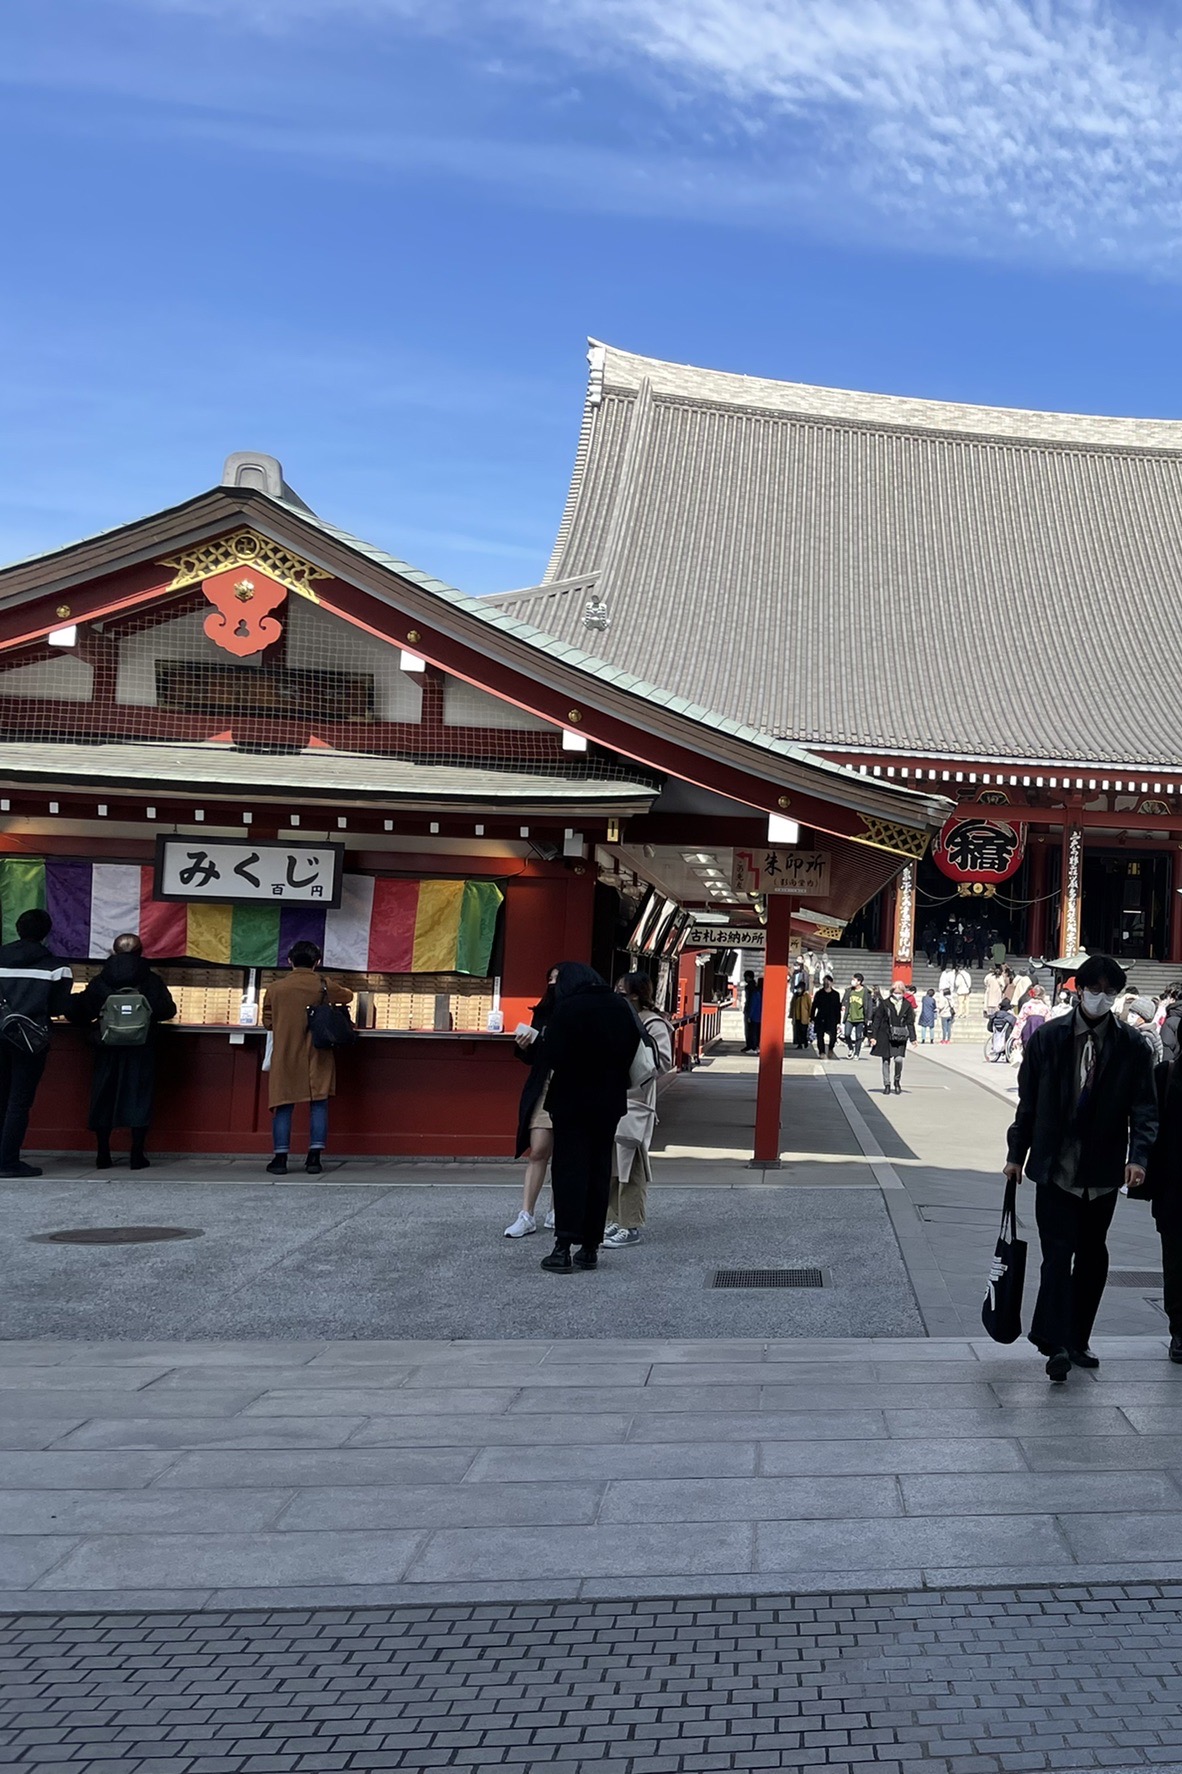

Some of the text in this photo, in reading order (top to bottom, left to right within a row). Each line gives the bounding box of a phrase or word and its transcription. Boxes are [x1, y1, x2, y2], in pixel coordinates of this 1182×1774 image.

[179, 851, 320, 888] みくじ
[764, 851, 826, 878] 朱印所
[691, 929, 765, 945] 古札お納め所
